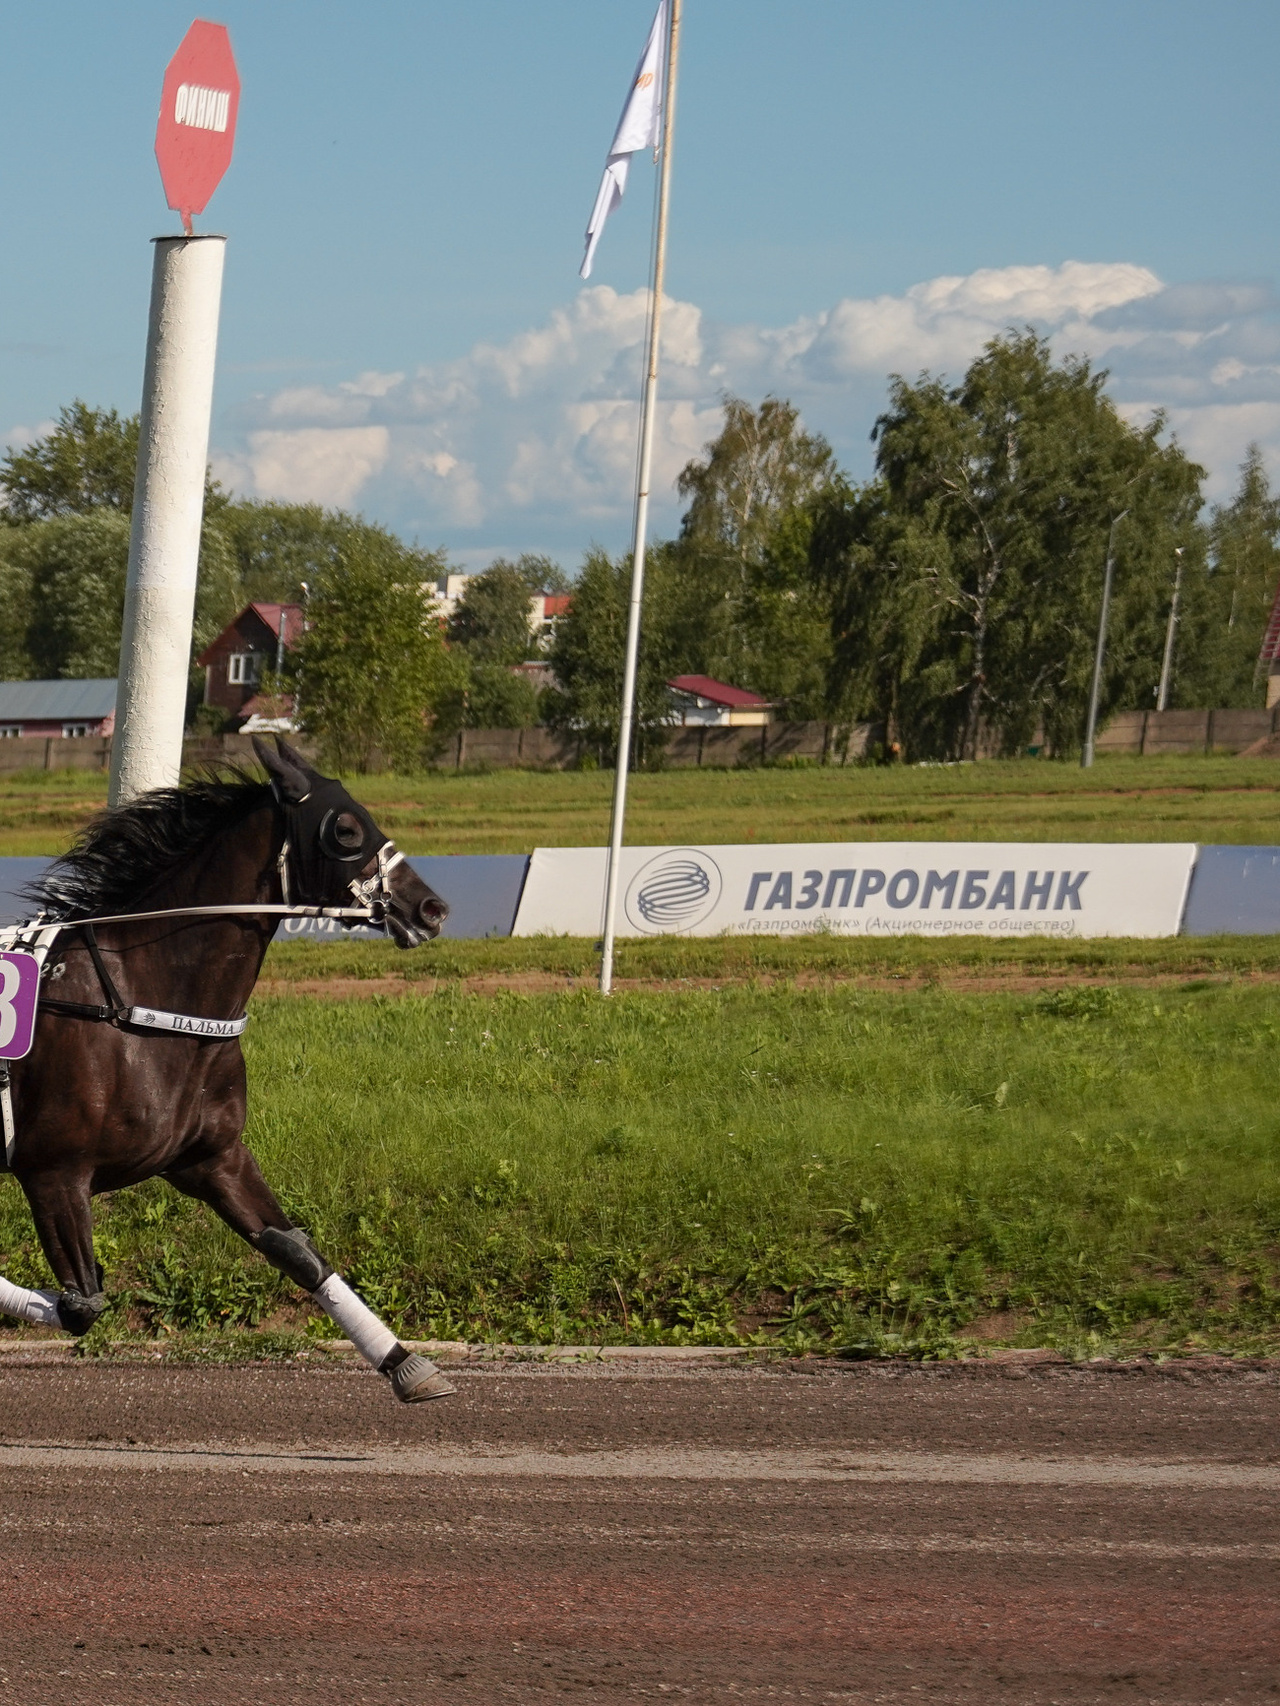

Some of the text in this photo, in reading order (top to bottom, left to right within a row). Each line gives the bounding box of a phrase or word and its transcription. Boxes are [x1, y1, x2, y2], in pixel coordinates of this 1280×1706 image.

[175, 83, 231, 132] ФИНИШ
[743, 868, 1091, 911] ГАЗПРОМБАНК
[171, 1016, 235, 1035] ПАЛЬМА
